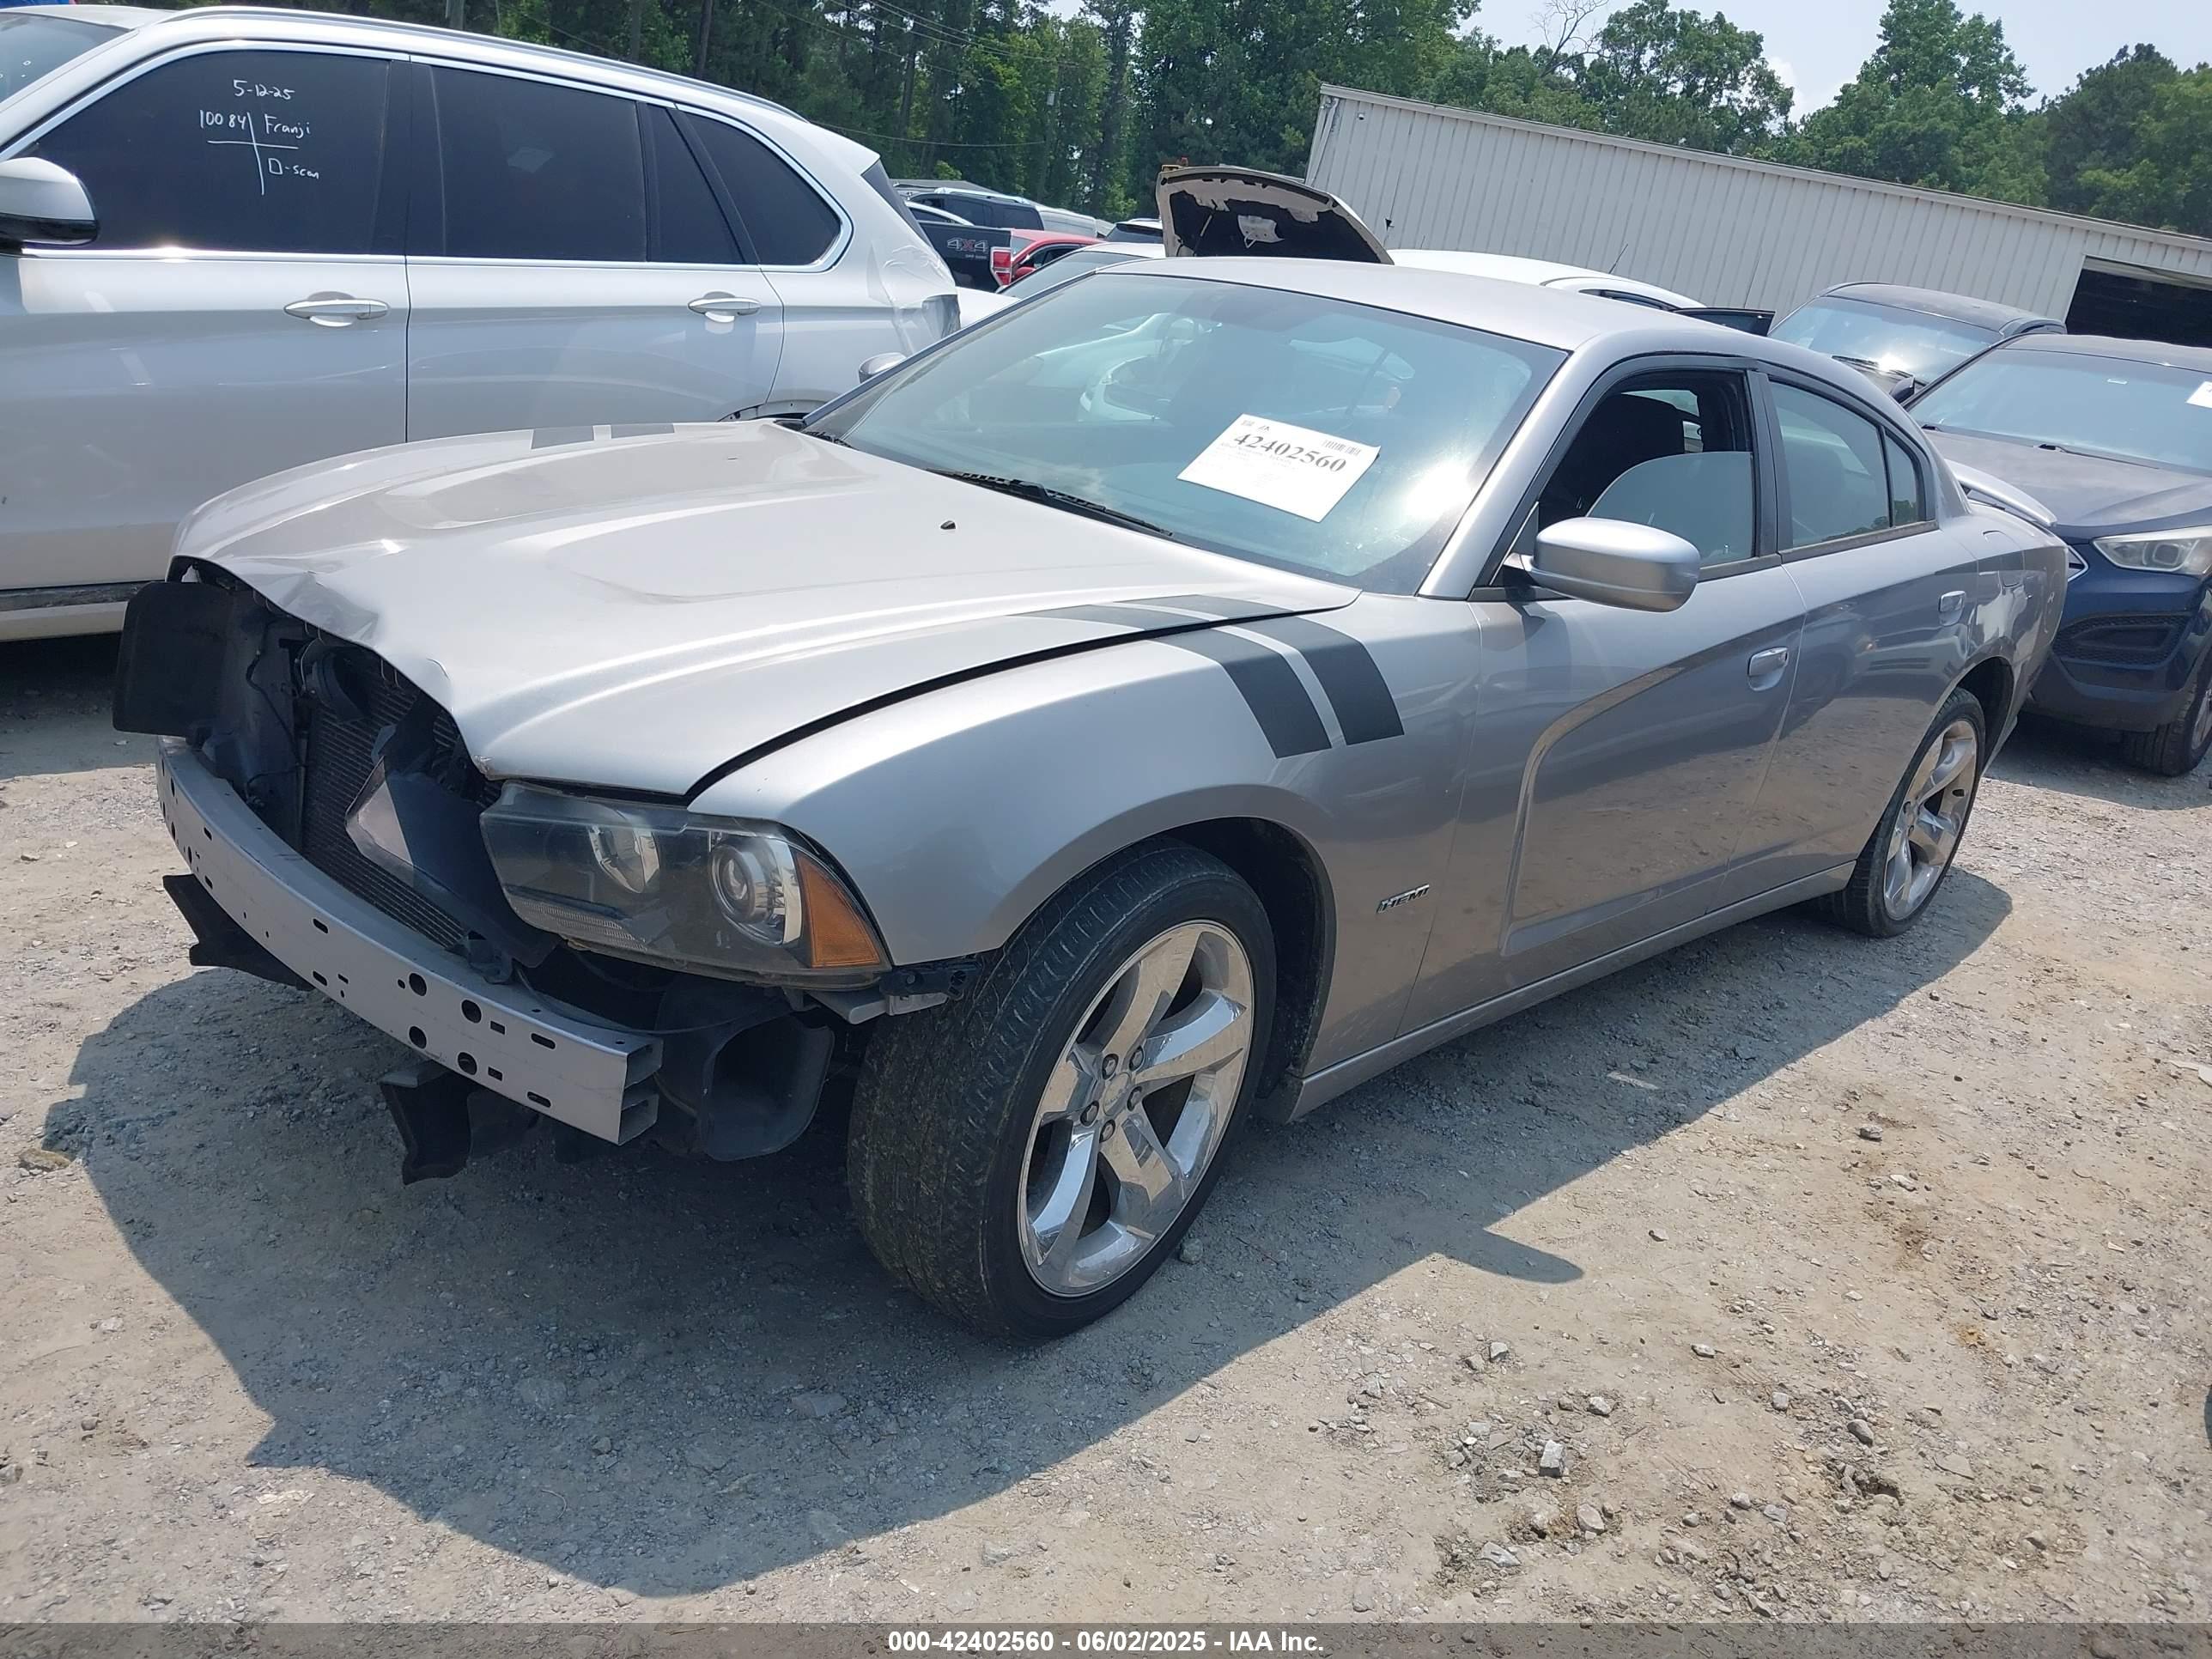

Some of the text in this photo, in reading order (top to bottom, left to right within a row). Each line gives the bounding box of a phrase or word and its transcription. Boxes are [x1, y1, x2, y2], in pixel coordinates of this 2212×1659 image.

[233, 79, 295, 100] 5-12-25
[1234, 434, 1346, 471] 42402560
[1376, 884, 1430, 913] HEMI
